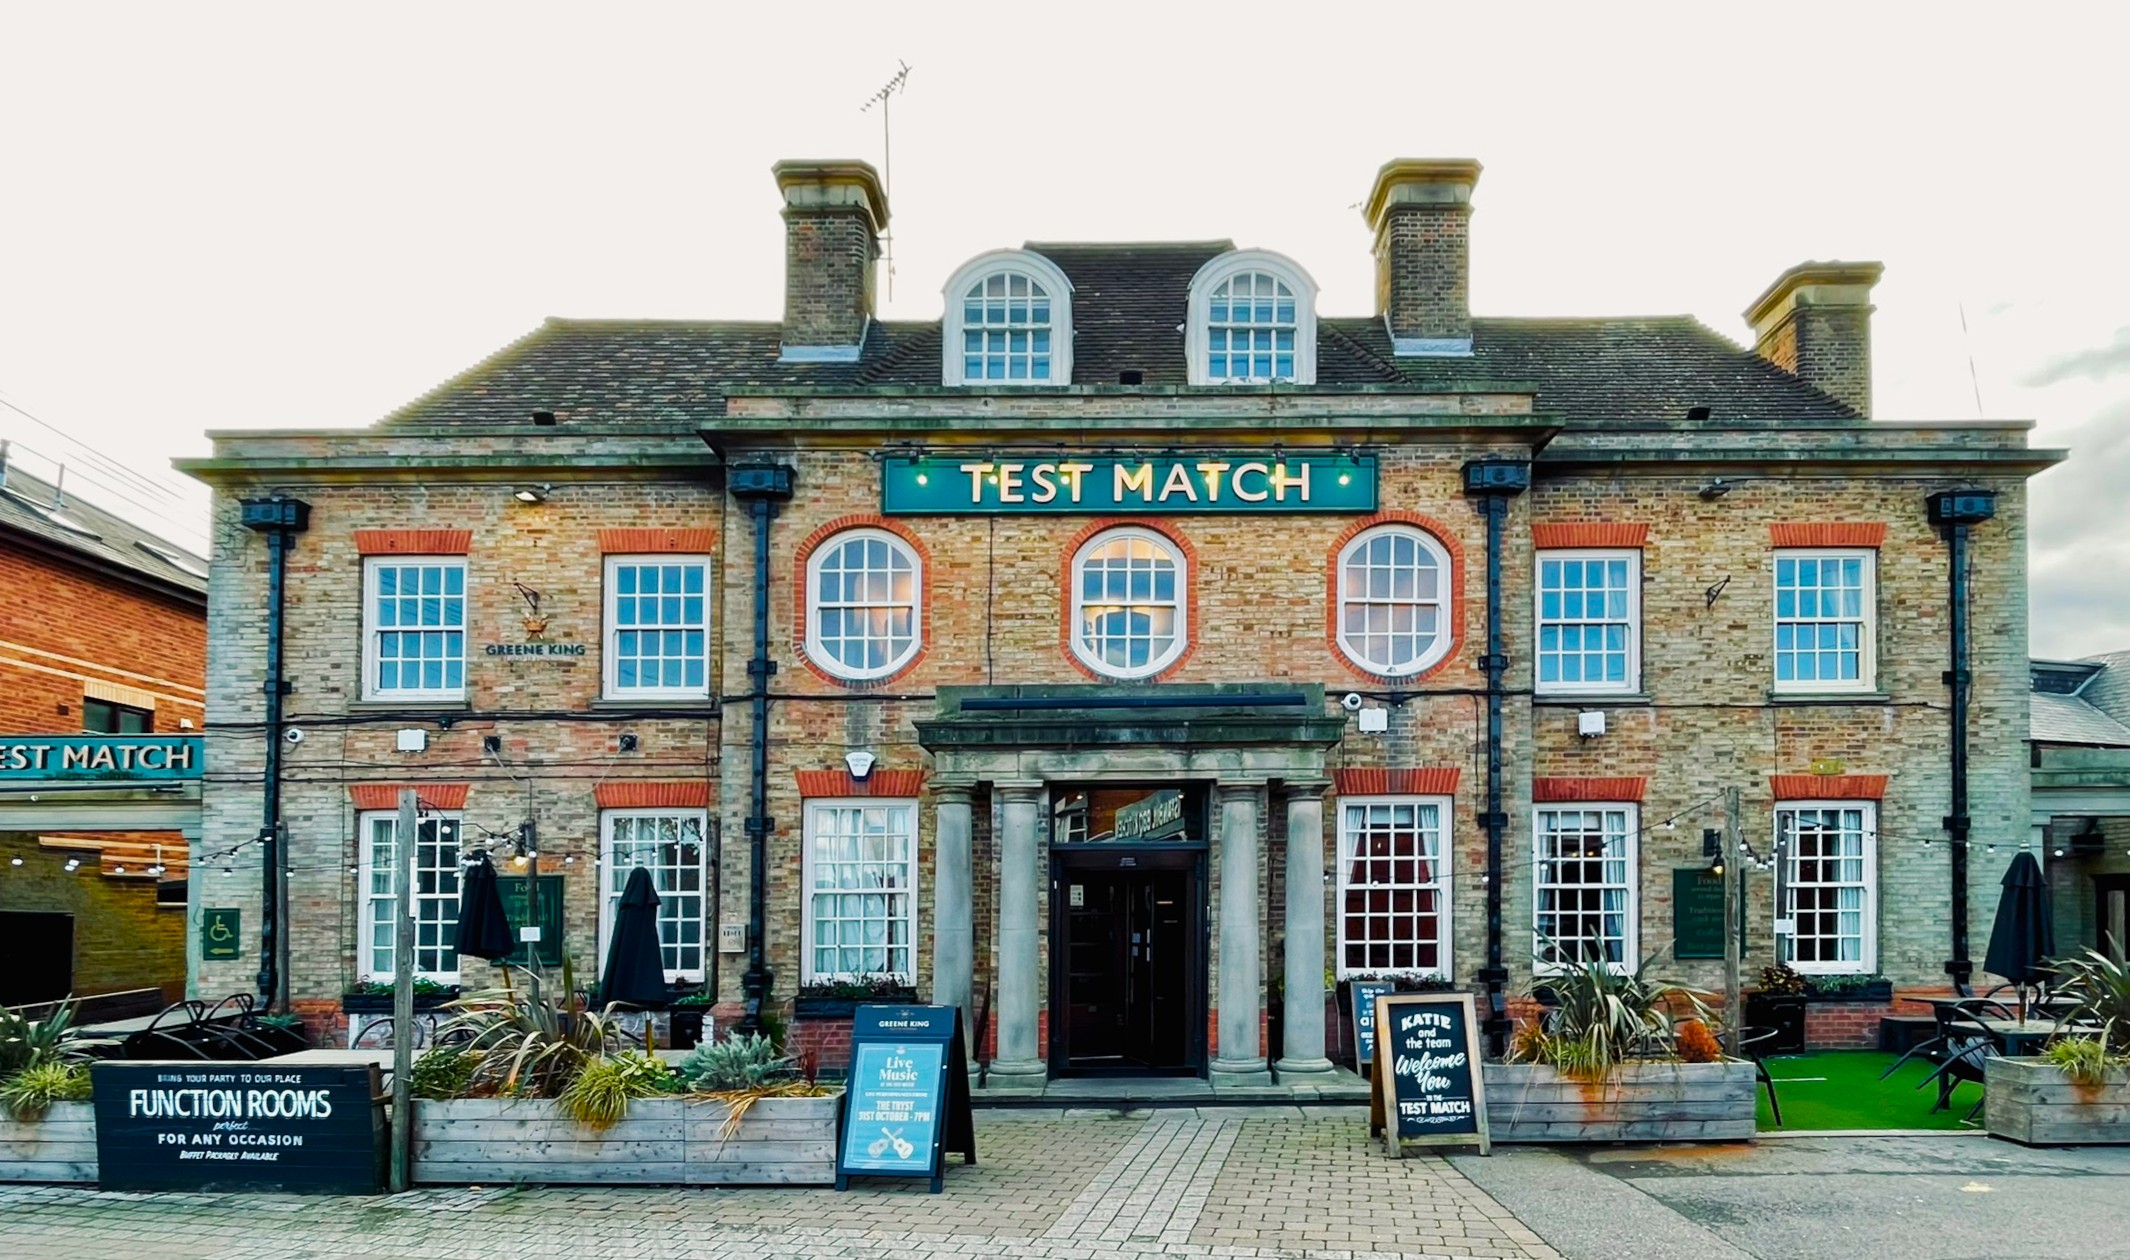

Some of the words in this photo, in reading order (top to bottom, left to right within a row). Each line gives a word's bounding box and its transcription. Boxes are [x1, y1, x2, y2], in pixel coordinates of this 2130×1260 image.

[960, 463, 1093, 503] TEST
[1113, 463, 1310, 502] MATCH
[485, 644, 543, 655] GREENE
[548, 644, 586, 655] KING
[62, 744, 190, 769] MATCH
[1401, 1012, 1451, 1031] KATIE
[1418, 1028, 1436, 1038] and
[1406, 1038, 1422, 1049] the
[1426, 1037, 1451, 1048] team
[886, 1056, 913, 1069] Live
[1395, 1051, 1466, 1076] Welcome
[186, 1074, 207, 1082] YOUR
[209, 1074, 236, 1082] PARTY
[241, 1074, 251, 1083] TO
[254, 1074, 272, 1083] OUR
[275, 1074, 302, 1083] PLACE
[879, 1068, 918, 1081] Music
[1414, 1070, 1451, 1093] You
[129, 1089, 242, 1118] FUNCTION
[248, 1090, 332, 1118] ROOMS
[876, 1101, 891, 1110] THE
[1400, 1102, 1428, 1115] TEST
[1430, 1101, 1471, 1114] MATCH
[875, 1111, 909, 1121] OCTOBER
[914, 1112, 930, 1122] 7PM
[212, 1121, 249, 1131] perfect
[158, 1134, 186, 1144] FOR
[191, 1134, 222, 1146] ANY
[228, 1135, 303, 1146] OCCASION
